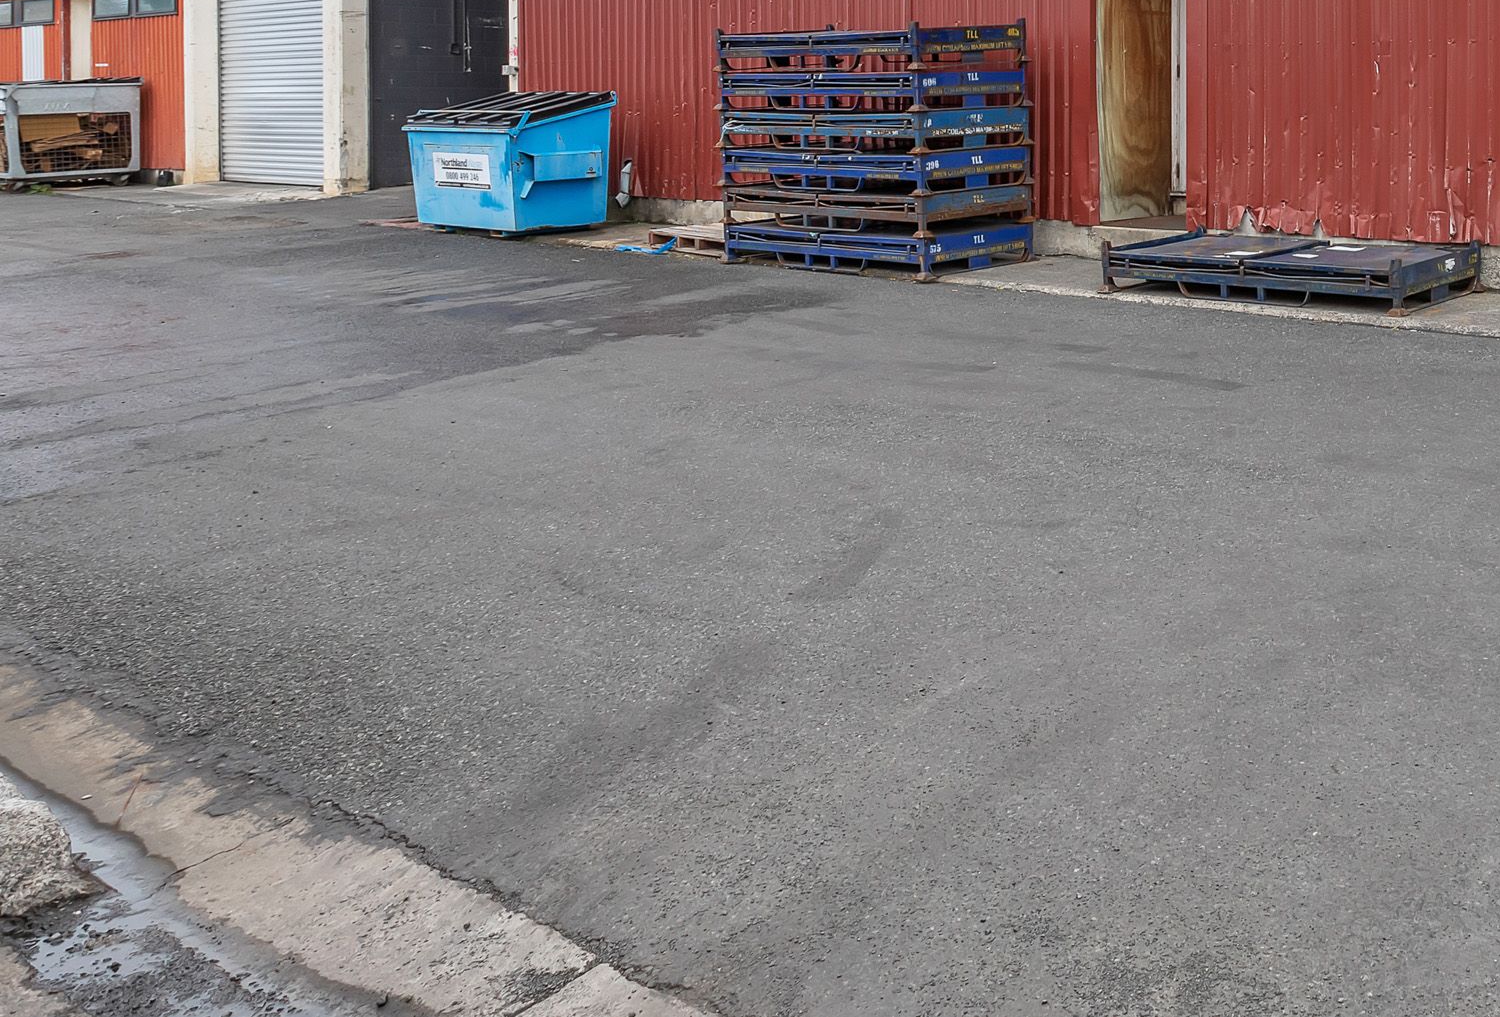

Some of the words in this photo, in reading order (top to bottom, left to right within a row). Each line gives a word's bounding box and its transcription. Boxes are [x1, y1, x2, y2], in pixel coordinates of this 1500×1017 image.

[966, 30, 979, 39] TLL
[968, 72, 979, 81] TLL
[442, 158, 468, 167] Northland
[972, 156, 983, 164] TLL
[446, 172, 459, 180] 0800
[974, 236, 985, 244] TLL
